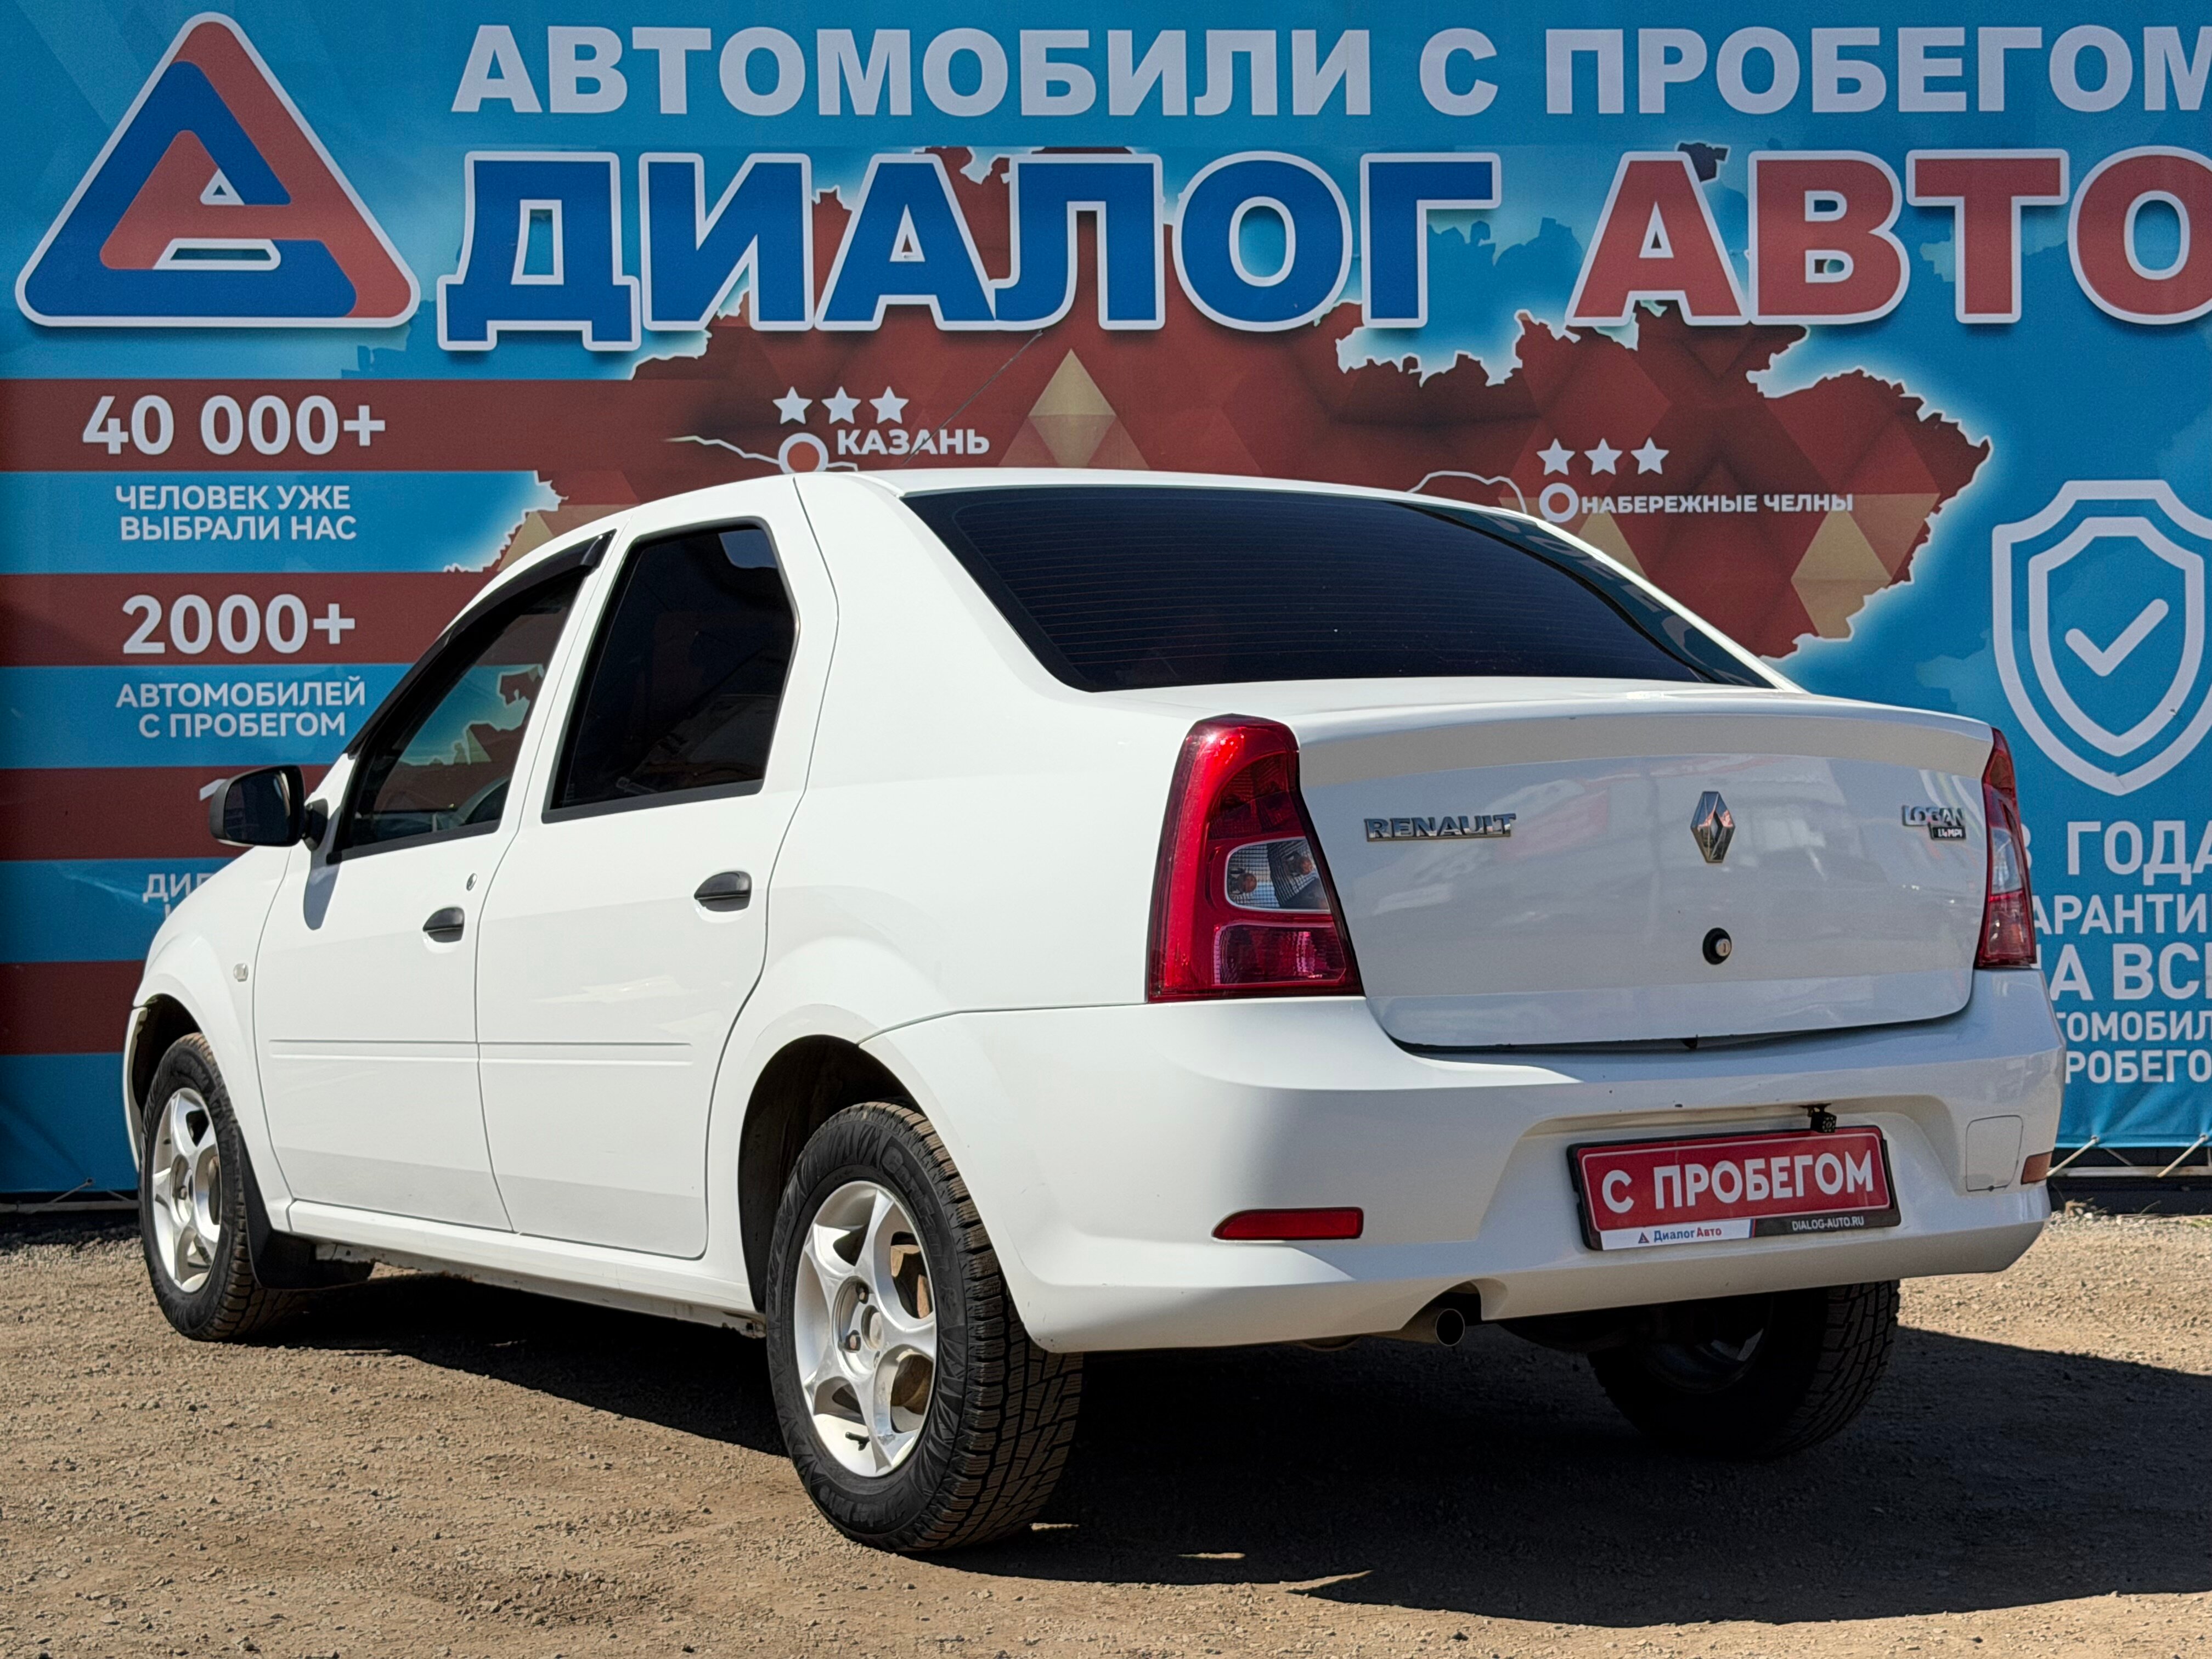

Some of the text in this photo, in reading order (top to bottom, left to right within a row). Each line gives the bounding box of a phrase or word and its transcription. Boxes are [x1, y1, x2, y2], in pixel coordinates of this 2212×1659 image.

[452, 25, 2212, 116] АВТОМОБИЛИ С ПРОБЕГОМ
[437, 146, 2212, 352] ДИАЛОГ АВТО
[82, 394, 386, 455] 40 000+
[837, 428, 990, 455] КАЗАНЬ
[116, 486, 350, 510] ЧЕЛОВЕК УЖЕ
[1582, 493, 1853, 514] НАБЕРЕЖНЫЕ ЧЕЛНЫ
[121, 516, 357, 541] ВЫБРАЛИ НАС
[122, 594, 356, 654] 2000+
[116, 676, 365, 708] АВТОМОБИЛЕЙ
[139, 712, 346, 738] С ПРОБЕГОМ
[1364, 812, 1516, 842] RENAULT
[2032, 893, 2212, 935] АРАНТИ
[2029, 942, 2212, 1001] А ВС
[2056, 1011, 2212, 1042] ОМОБИЛ
[2064, 1049, 2212, 1084] РОБЕГО
[1601, 1150, 1875, 1214] С ПРОБЕГОМ
[1791, 1216, 1865, 1231] DIALOG-AUTO.RU
